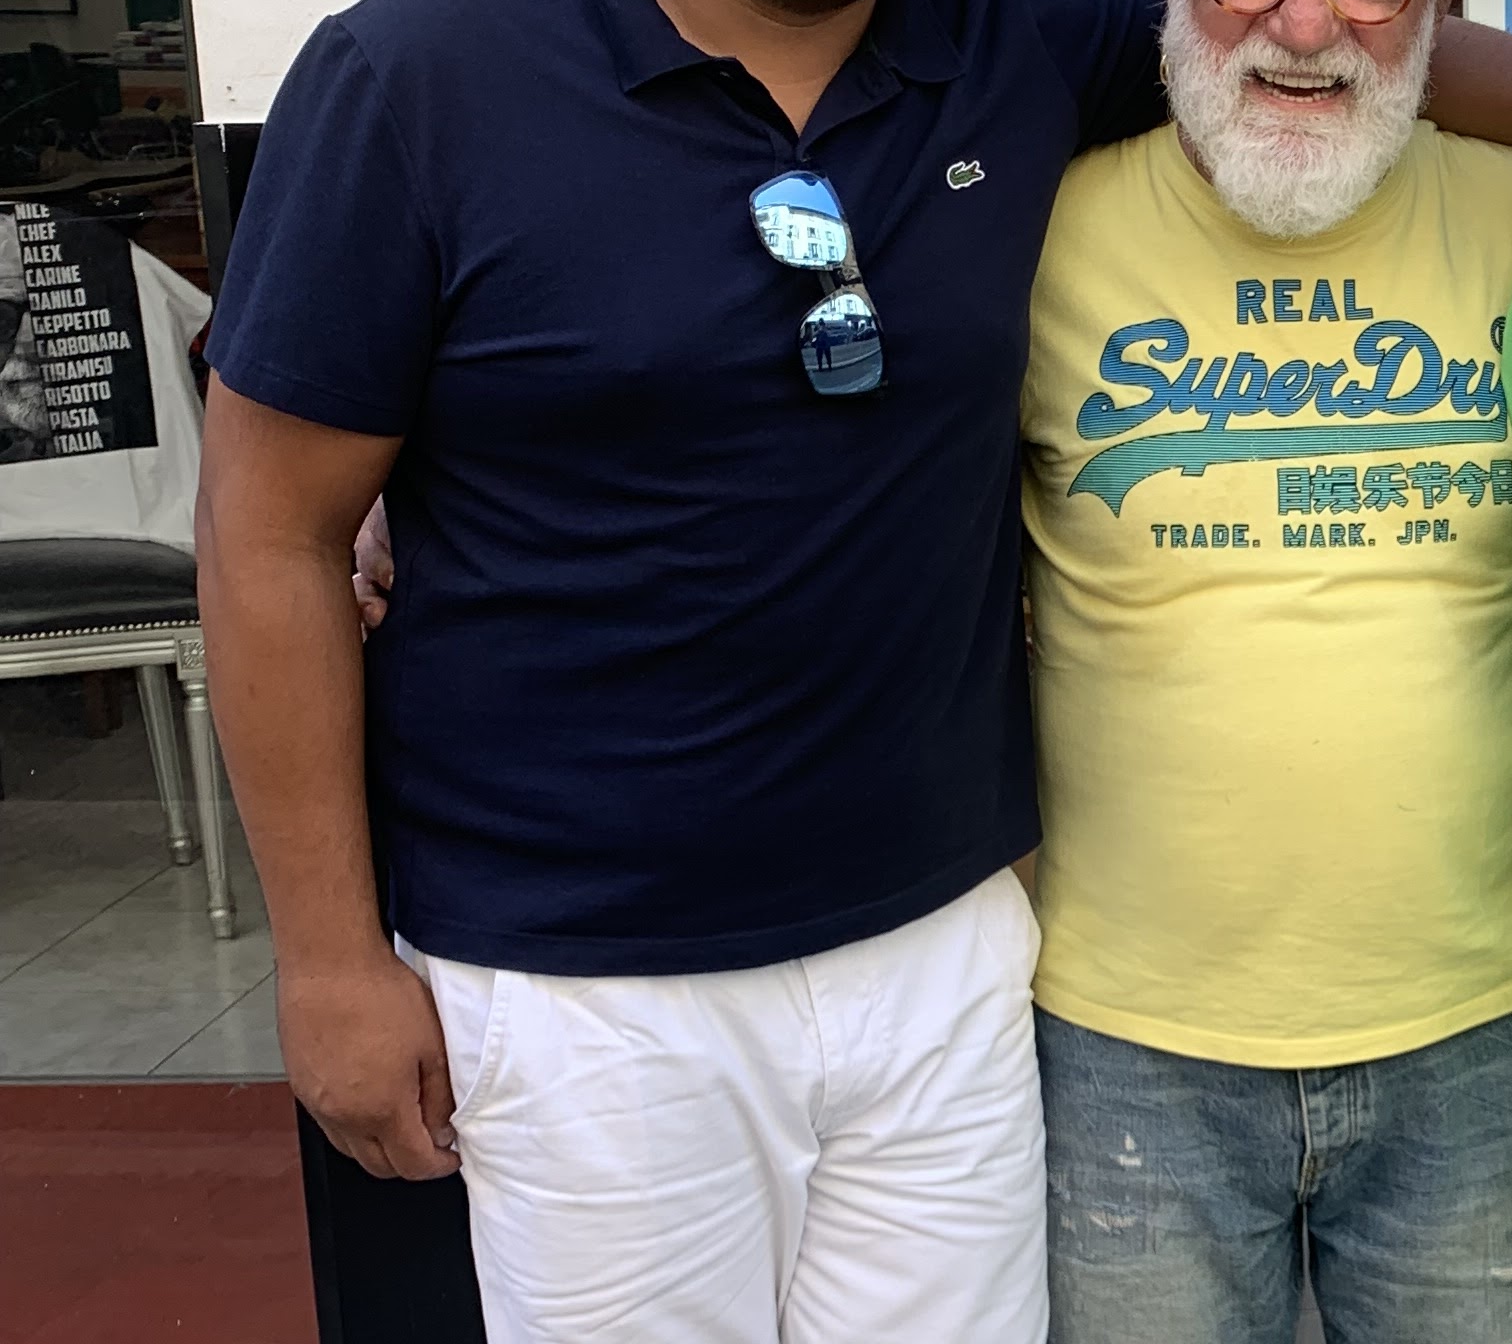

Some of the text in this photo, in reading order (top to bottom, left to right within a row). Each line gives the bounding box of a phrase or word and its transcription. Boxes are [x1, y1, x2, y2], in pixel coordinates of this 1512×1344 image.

[14, 202, 50, 220] NICE
[18, 222, 57, 242] CHEF
[23, 244, 63, 264] ALEX
[25, 265, 82, 288] CARINE
[28, 287, 87, 311] DANILO
[1236, 278, 1373, 324] REAL
[32, 308, 111, 335] GEPPETTO
[36, 330, 132, 358] CARBONARA
[40, 355, 113, 382] TIRAMISU
[44, 381, 112, 407] RISOTTO
[49, 407, 100, 430] PASTA
[53, 430, 104, 454] ITALIA
[1151, 519, 1458, 549] TRADE. MARK. JPN.
